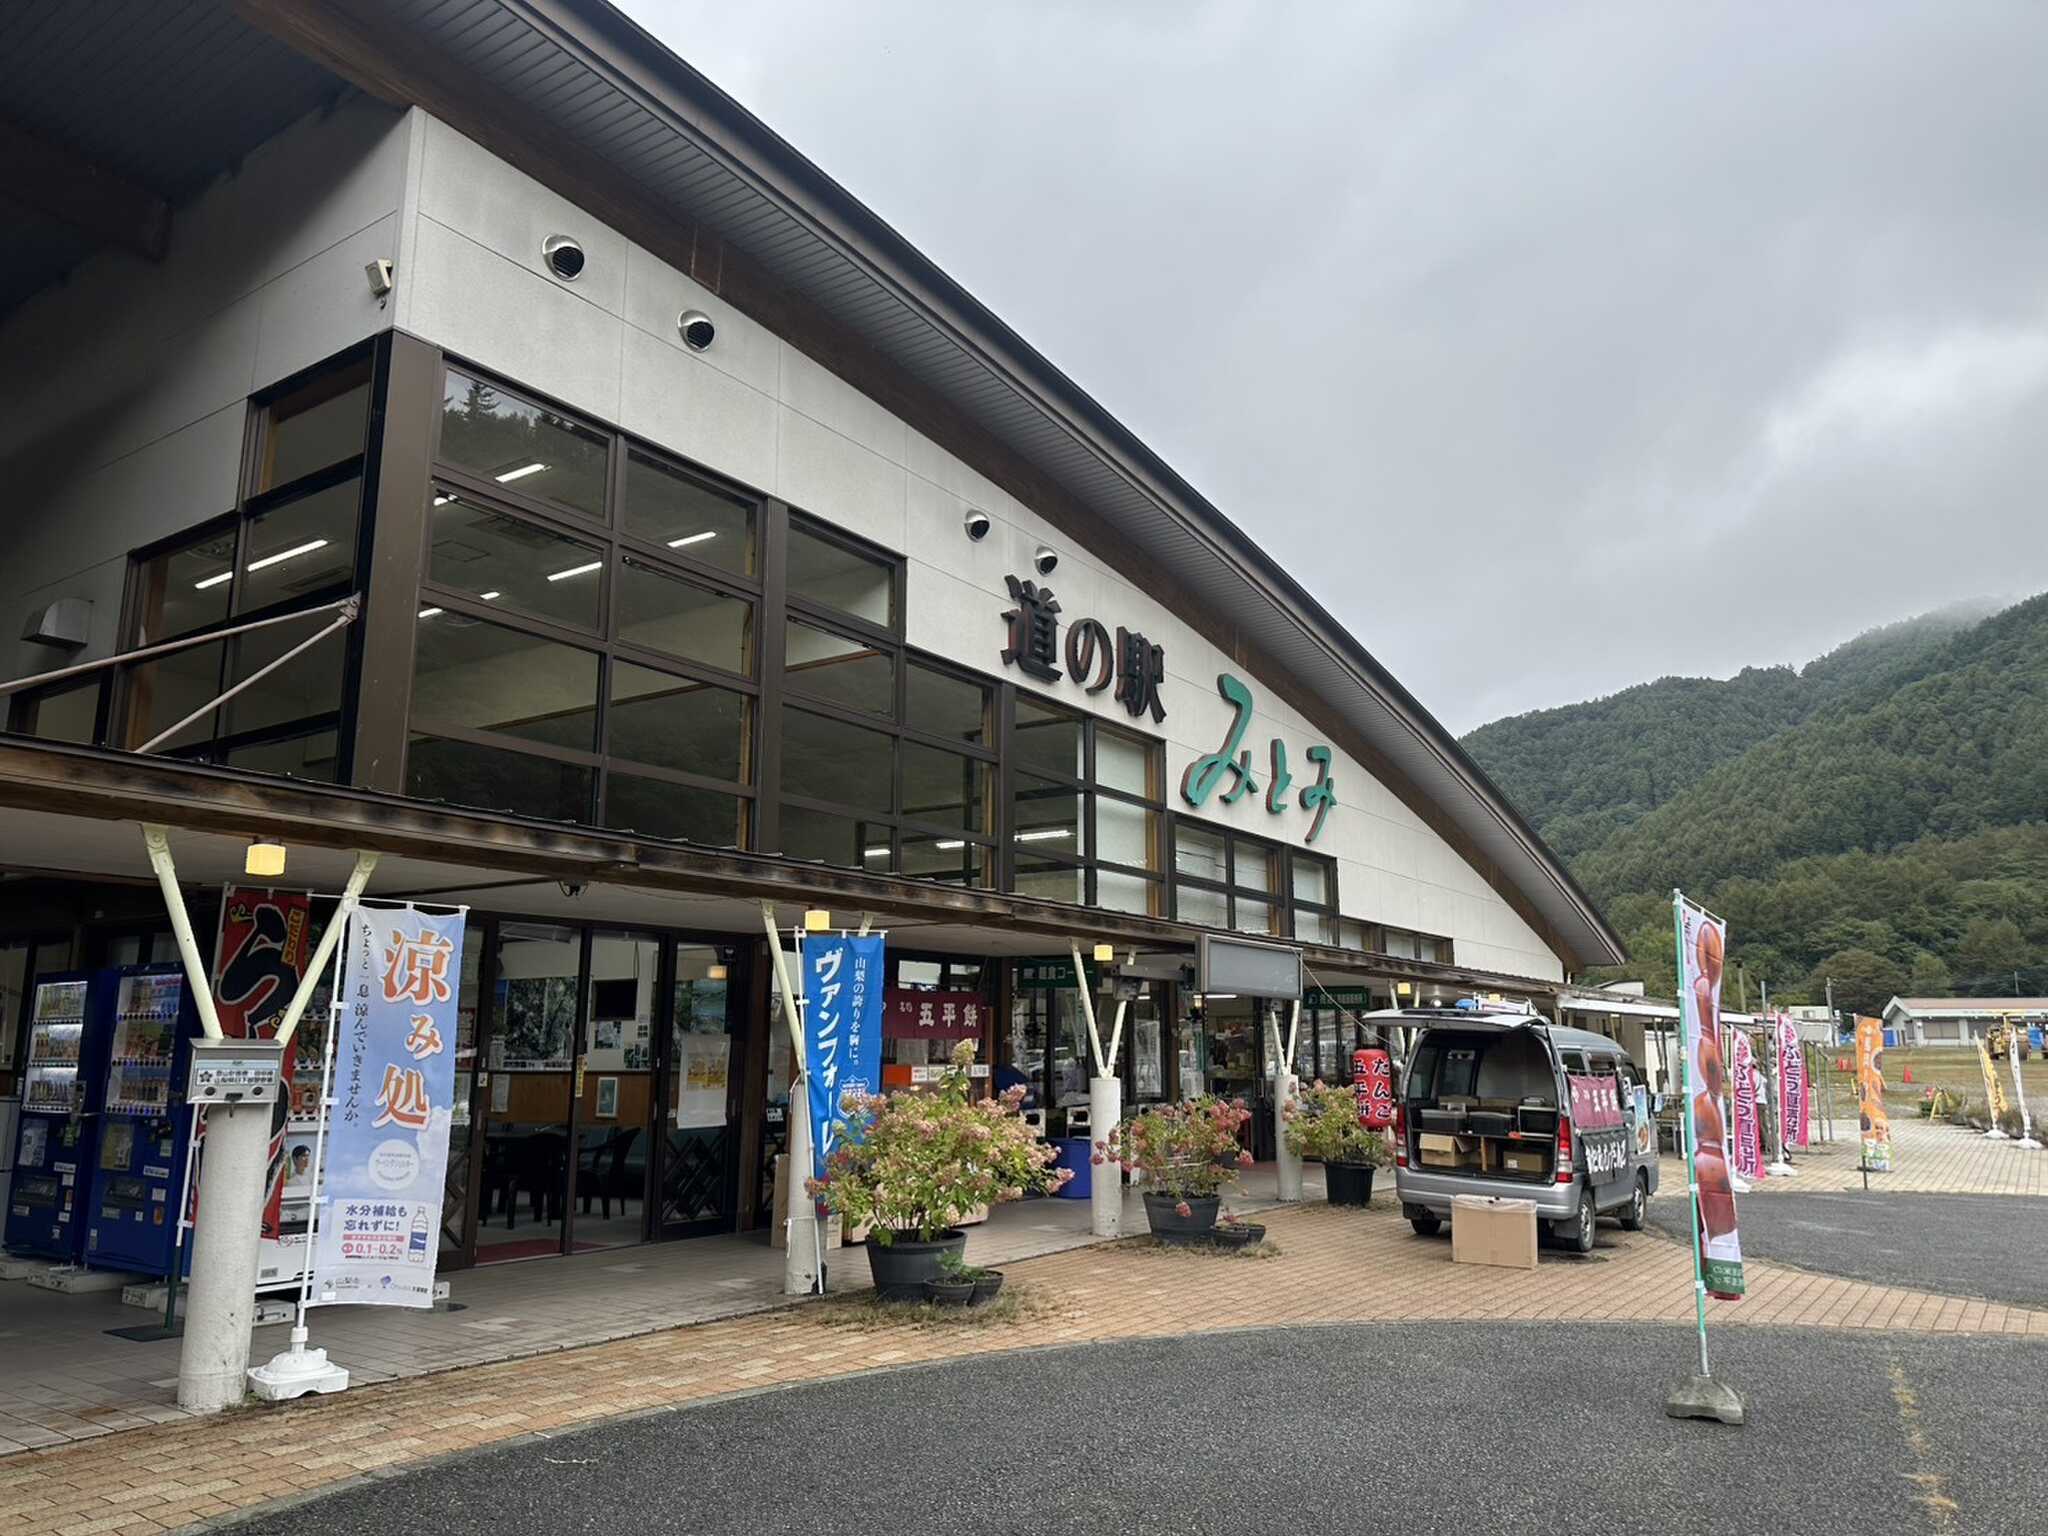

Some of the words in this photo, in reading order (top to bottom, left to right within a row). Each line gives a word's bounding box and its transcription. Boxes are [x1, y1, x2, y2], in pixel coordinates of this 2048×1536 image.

[1000, 574, 1168, 724] 道の駅
[1180, 673, 1337, 842] みとみ
[371, 928, 454, 1131] 涼み処
[1373, 1057, 1391, 1121] だんご
[345, 1204, 408, 1218] 水分補給も
